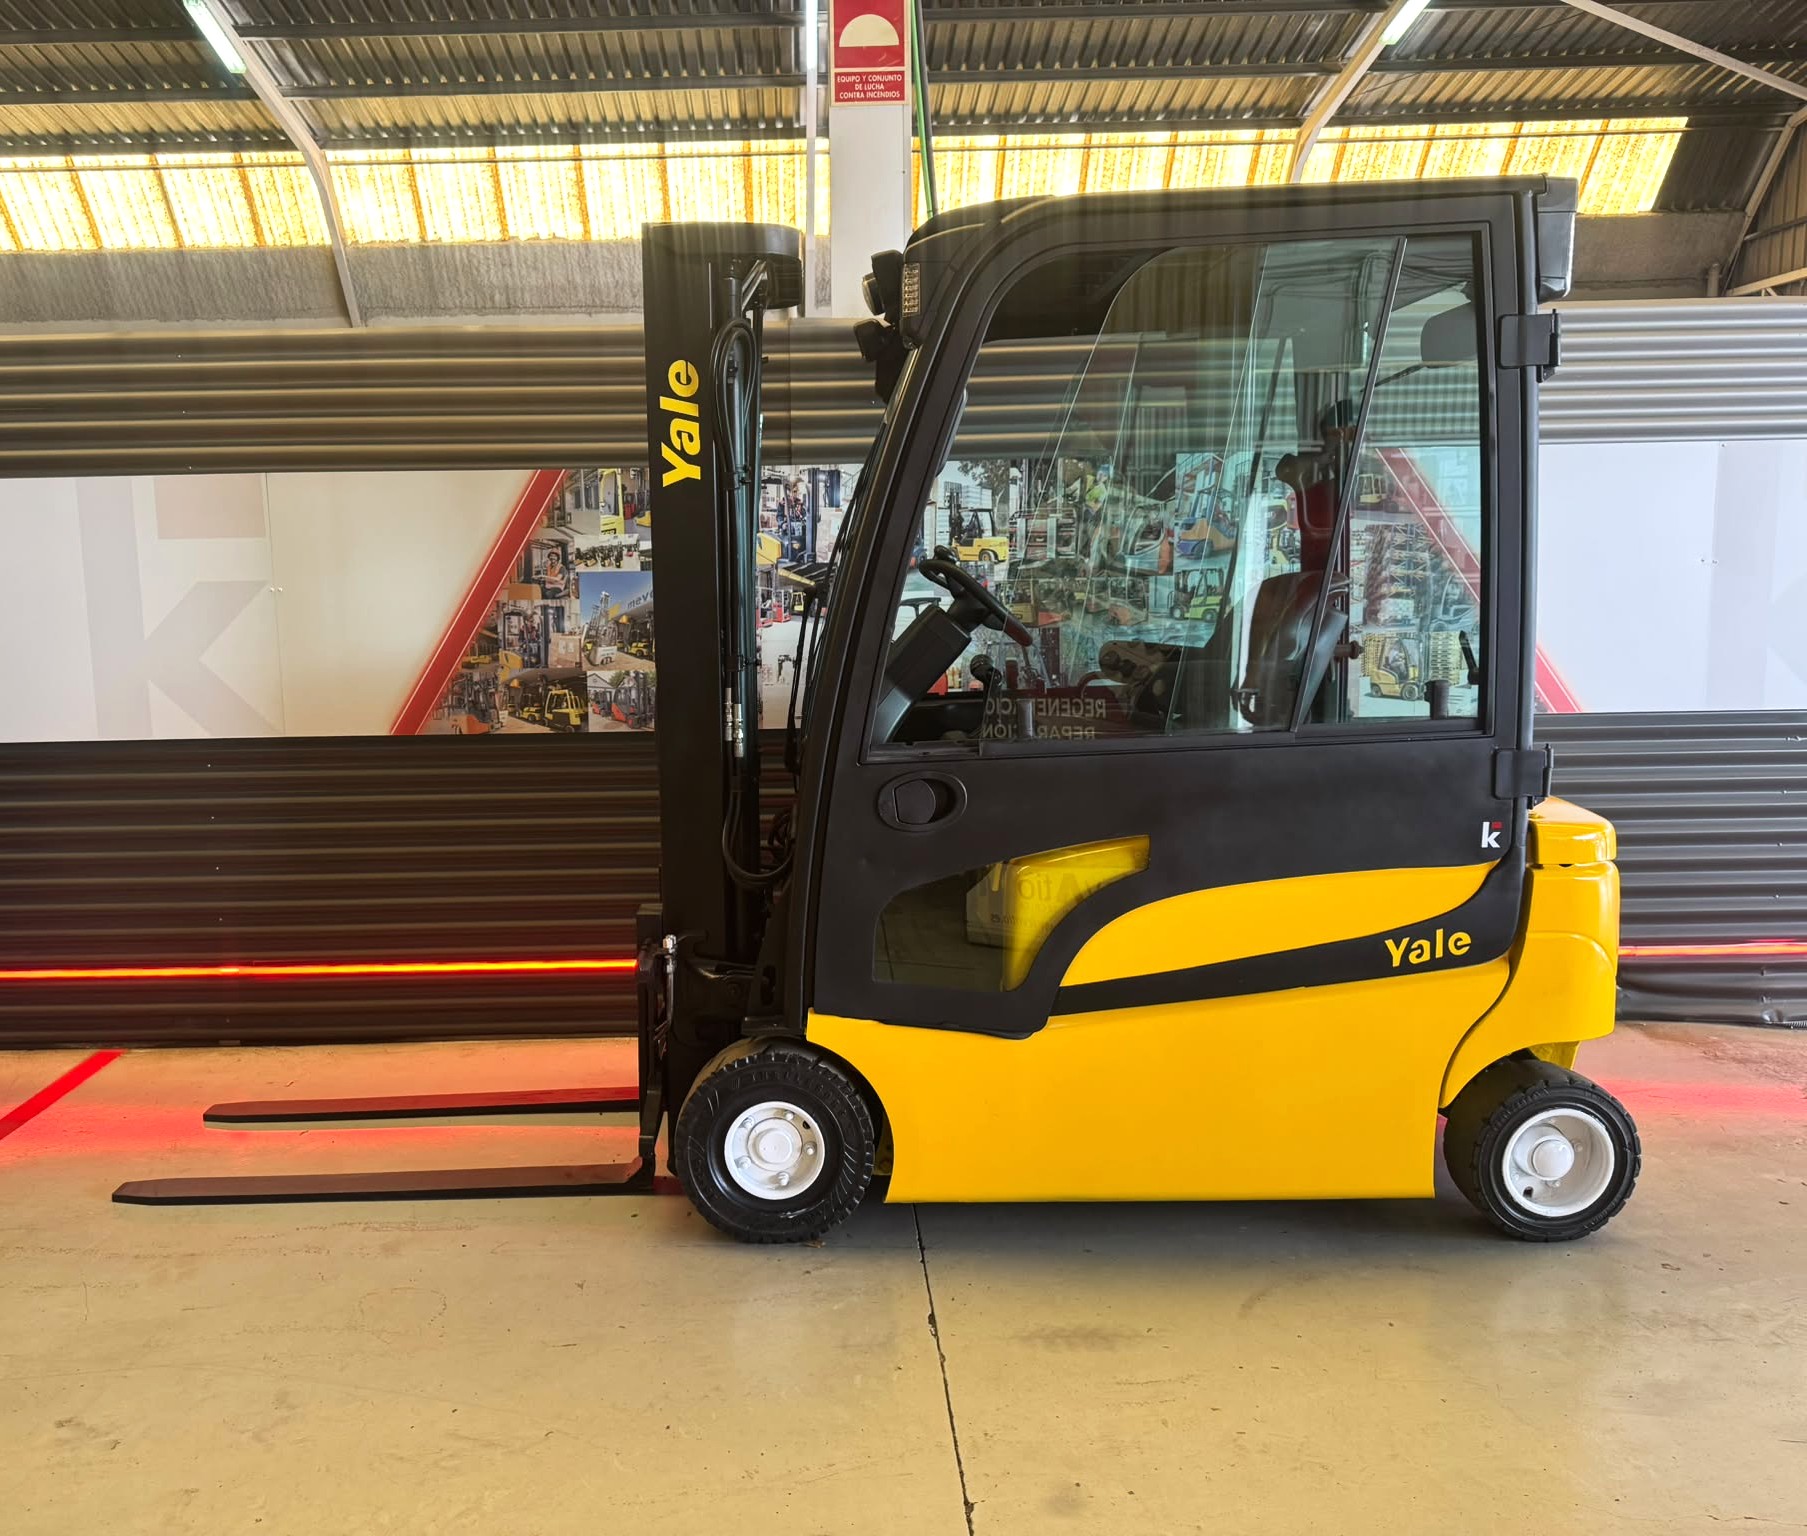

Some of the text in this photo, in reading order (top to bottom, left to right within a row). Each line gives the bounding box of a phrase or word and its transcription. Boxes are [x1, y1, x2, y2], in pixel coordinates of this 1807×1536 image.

[837, 75, 860, 83] EQUIPO
[868, 74, 902, 82] CONJUNTO
[854, 83, 862, 91] DE
[839, 91, 864, 99] CONTRA
[659, 359, 701, 488] Yale
[1384, 928, 1472, 968] Yale
